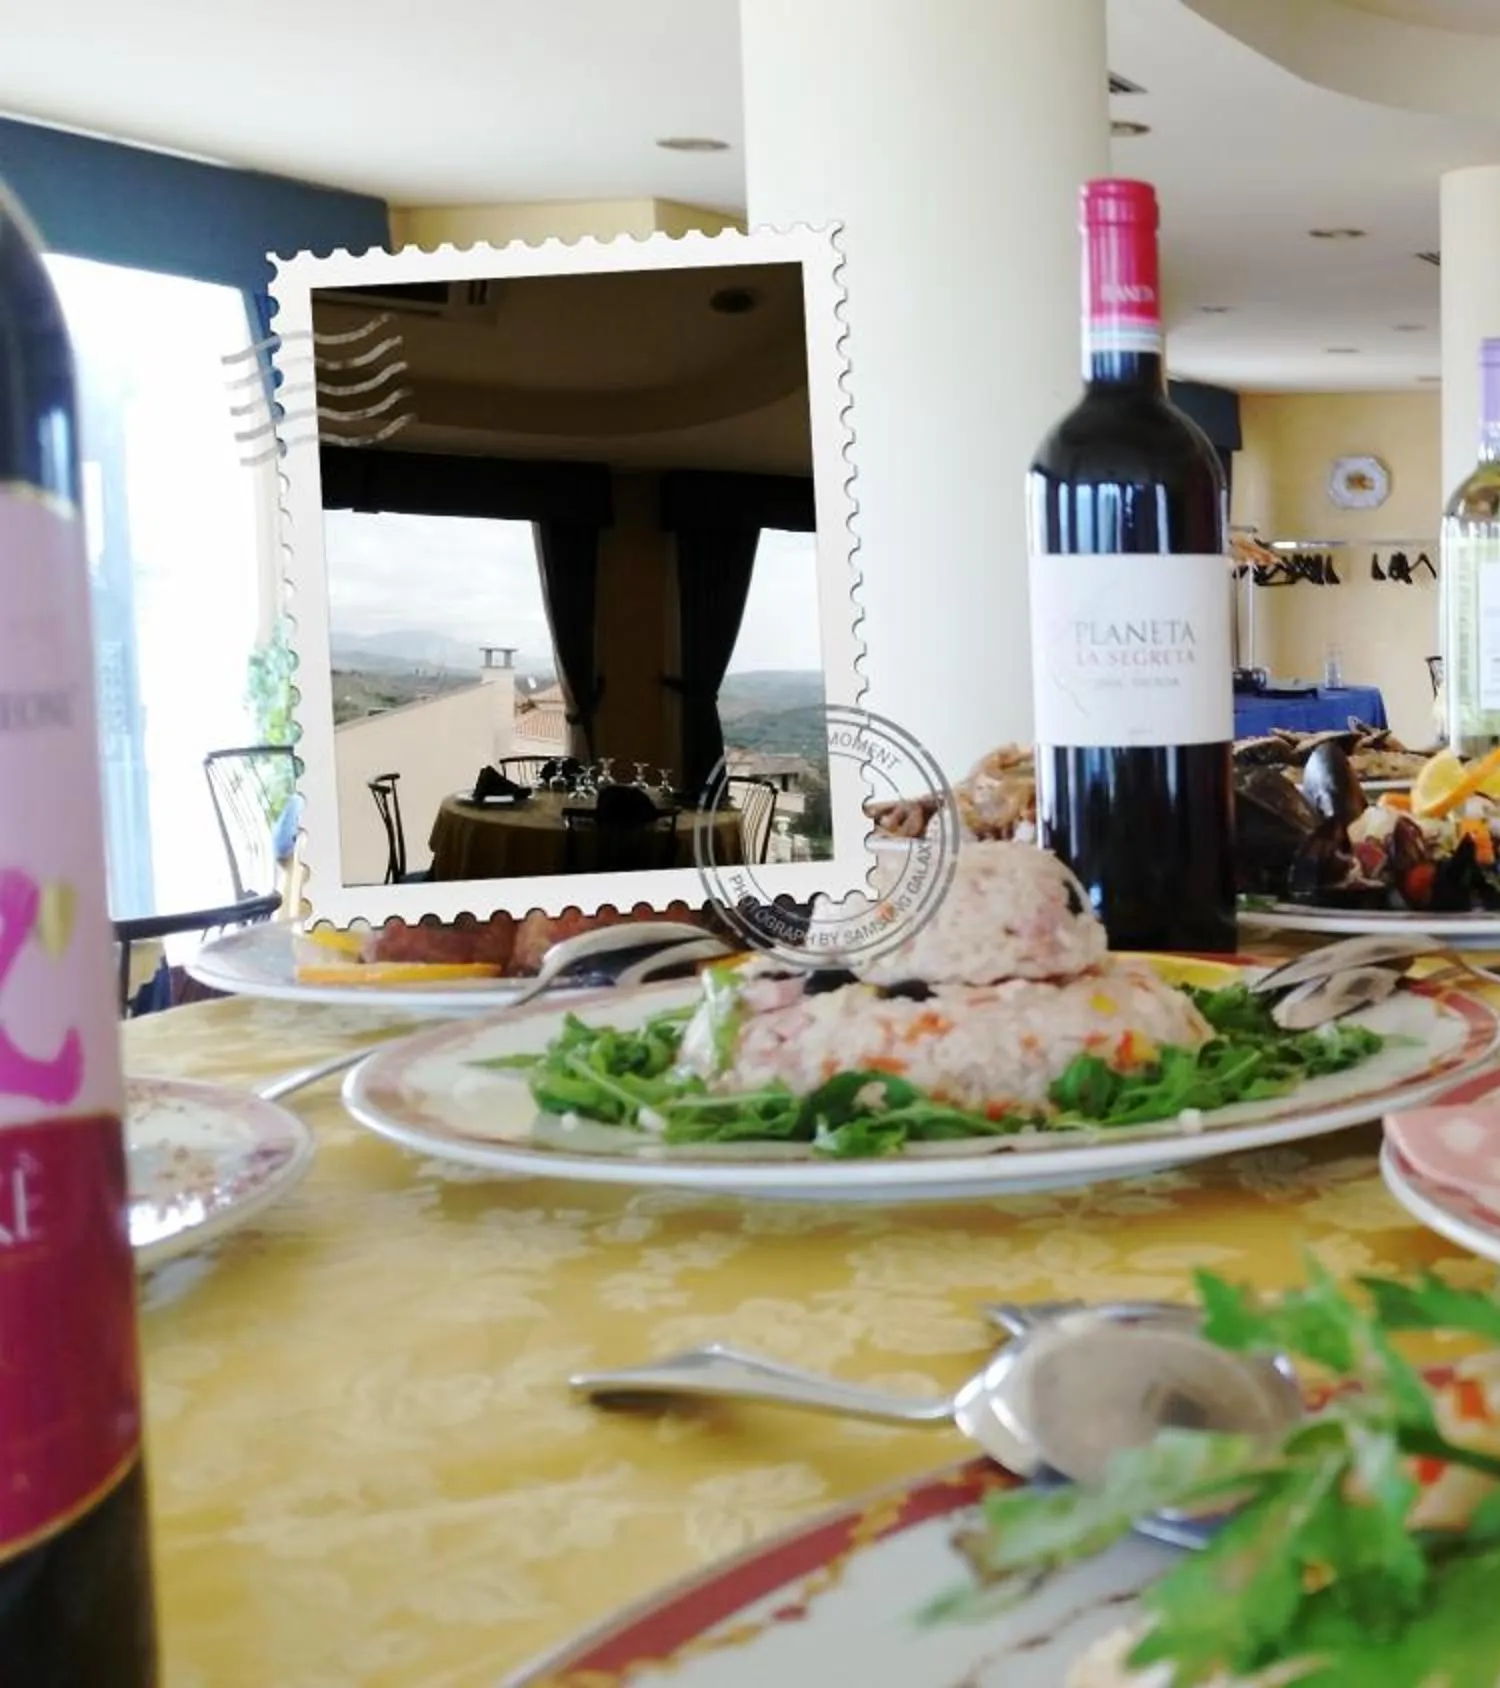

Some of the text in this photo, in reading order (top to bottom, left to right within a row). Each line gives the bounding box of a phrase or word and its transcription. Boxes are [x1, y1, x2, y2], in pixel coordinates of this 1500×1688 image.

[1074, 619, 1197, 646] PLANETA
[1077, 648, 1196, 667] LA SEGRETA
